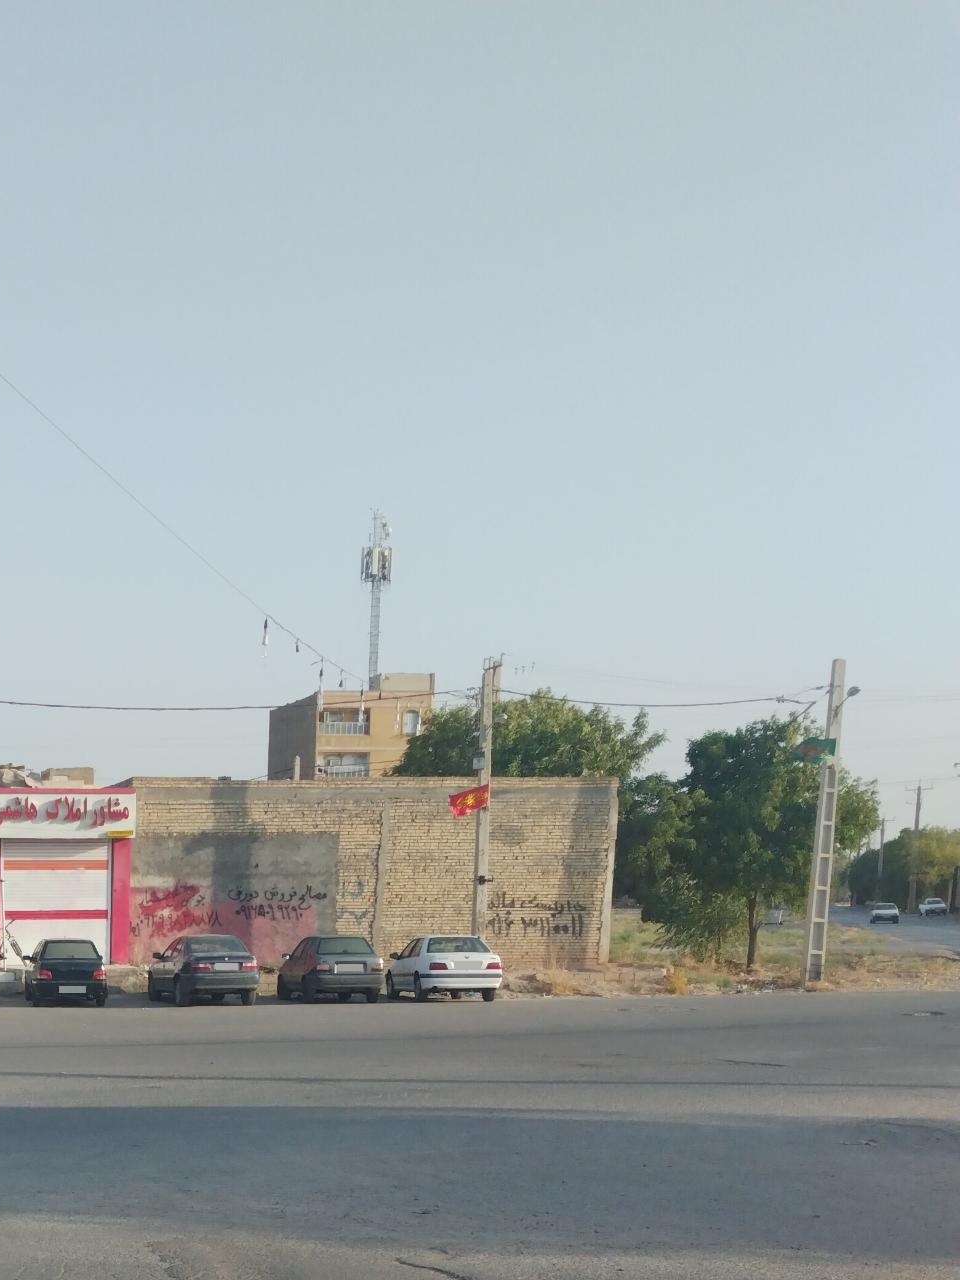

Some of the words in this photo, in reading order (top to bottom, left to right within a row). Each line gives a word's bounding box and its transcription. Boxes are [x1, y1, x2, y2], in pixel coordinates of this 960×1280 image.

[45, 796, 88, 821] املاک
[91, 797, 130, 827] مشاور
[298, 884, 328, 910] مصالح
